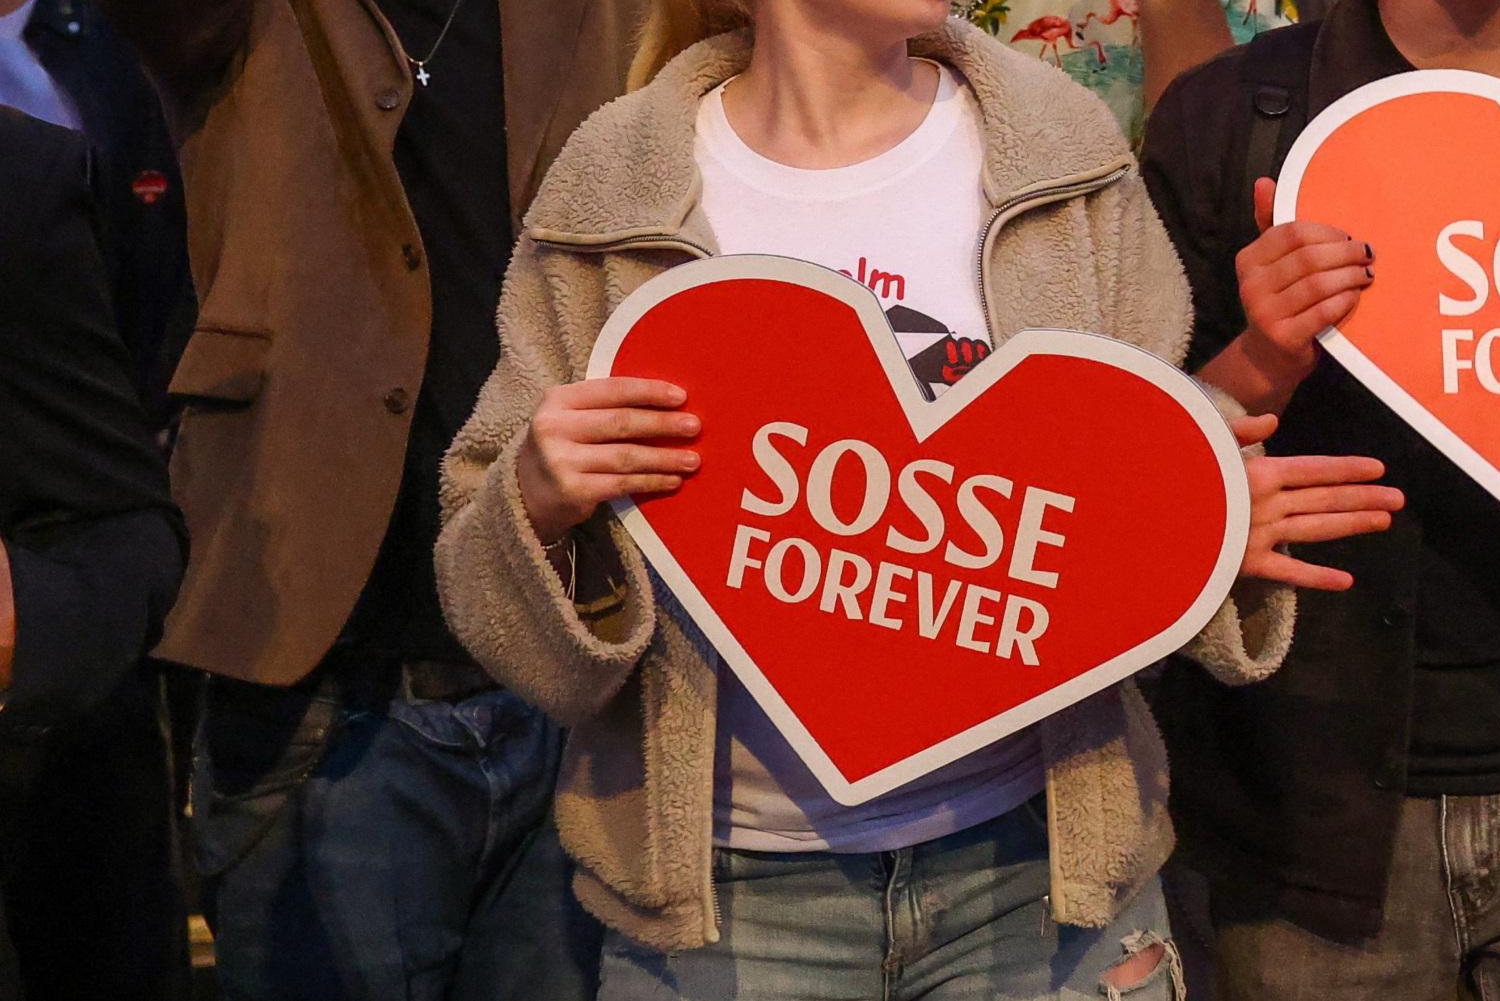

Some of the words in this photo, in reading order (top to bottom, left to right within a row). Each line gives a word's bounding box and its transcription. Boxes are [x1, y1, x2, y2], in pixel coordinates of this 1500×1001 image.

[838, 256, 906, 301] lm
[740, 421, 1076, 589] SOSSE
[726, 525, 1051, 666] FOREVER
